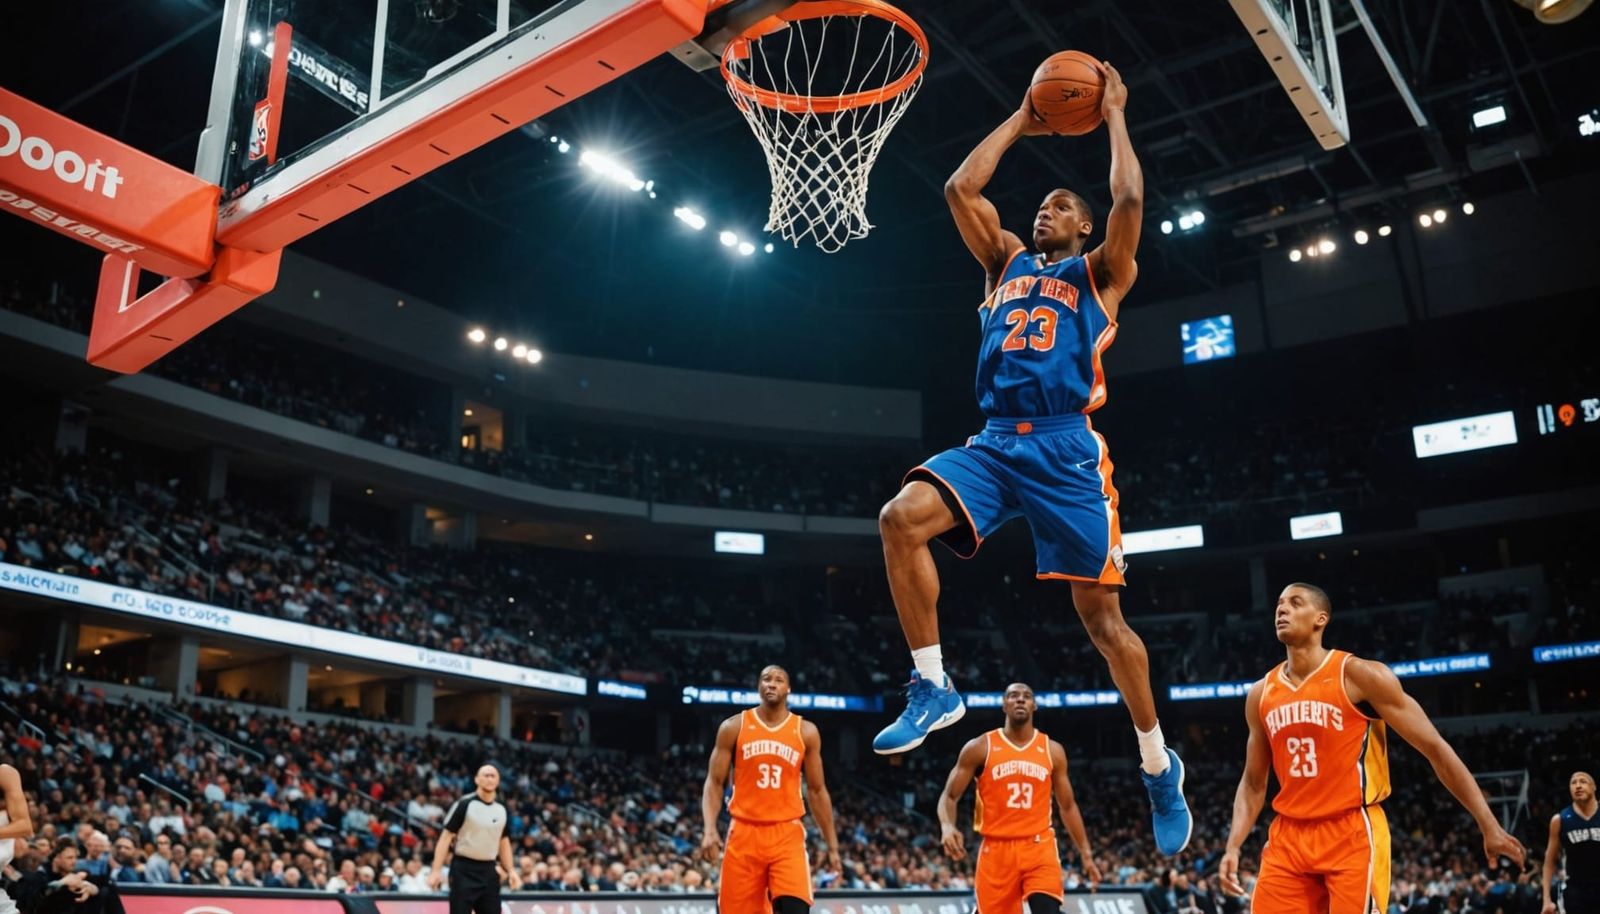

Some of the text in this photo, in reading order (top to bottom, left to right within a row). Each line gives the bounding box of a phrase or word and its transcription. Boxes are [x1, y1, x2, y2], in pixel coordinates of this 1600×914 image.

[1001, 306, 1059, 352] 23
[756, 763, 783, 789] 33
[1006, 782, 1033, 809] 23
